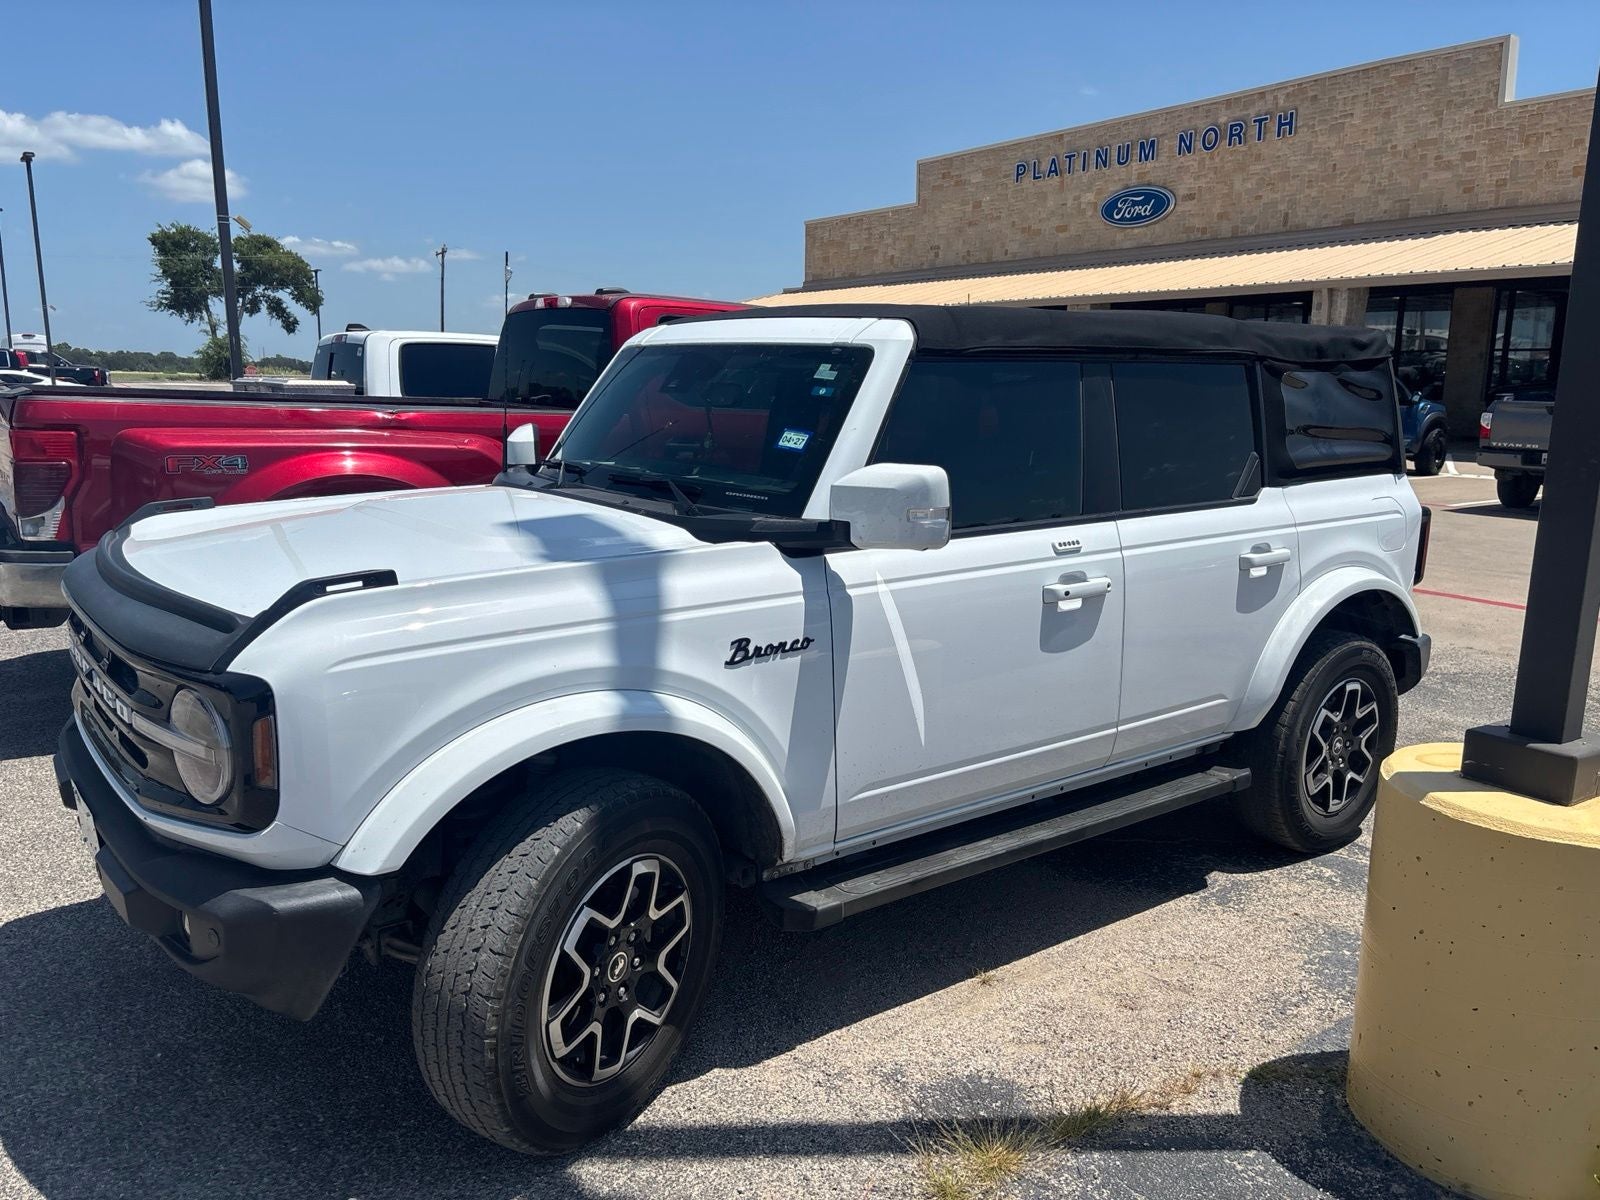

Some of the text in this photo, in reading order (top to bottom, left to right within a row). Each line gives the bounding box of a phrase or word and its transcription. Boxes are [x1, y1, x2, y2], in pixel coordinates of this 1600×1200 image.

[1015, 110, 1296, 184] PLATINUM NORTH
[1113, 195, 1154, 220] Ford
[165, 455, 248, 474] FX4
[724, 637, 815, 665] Bronco
[510, 840, 606, 1097] BRIDGESTON
